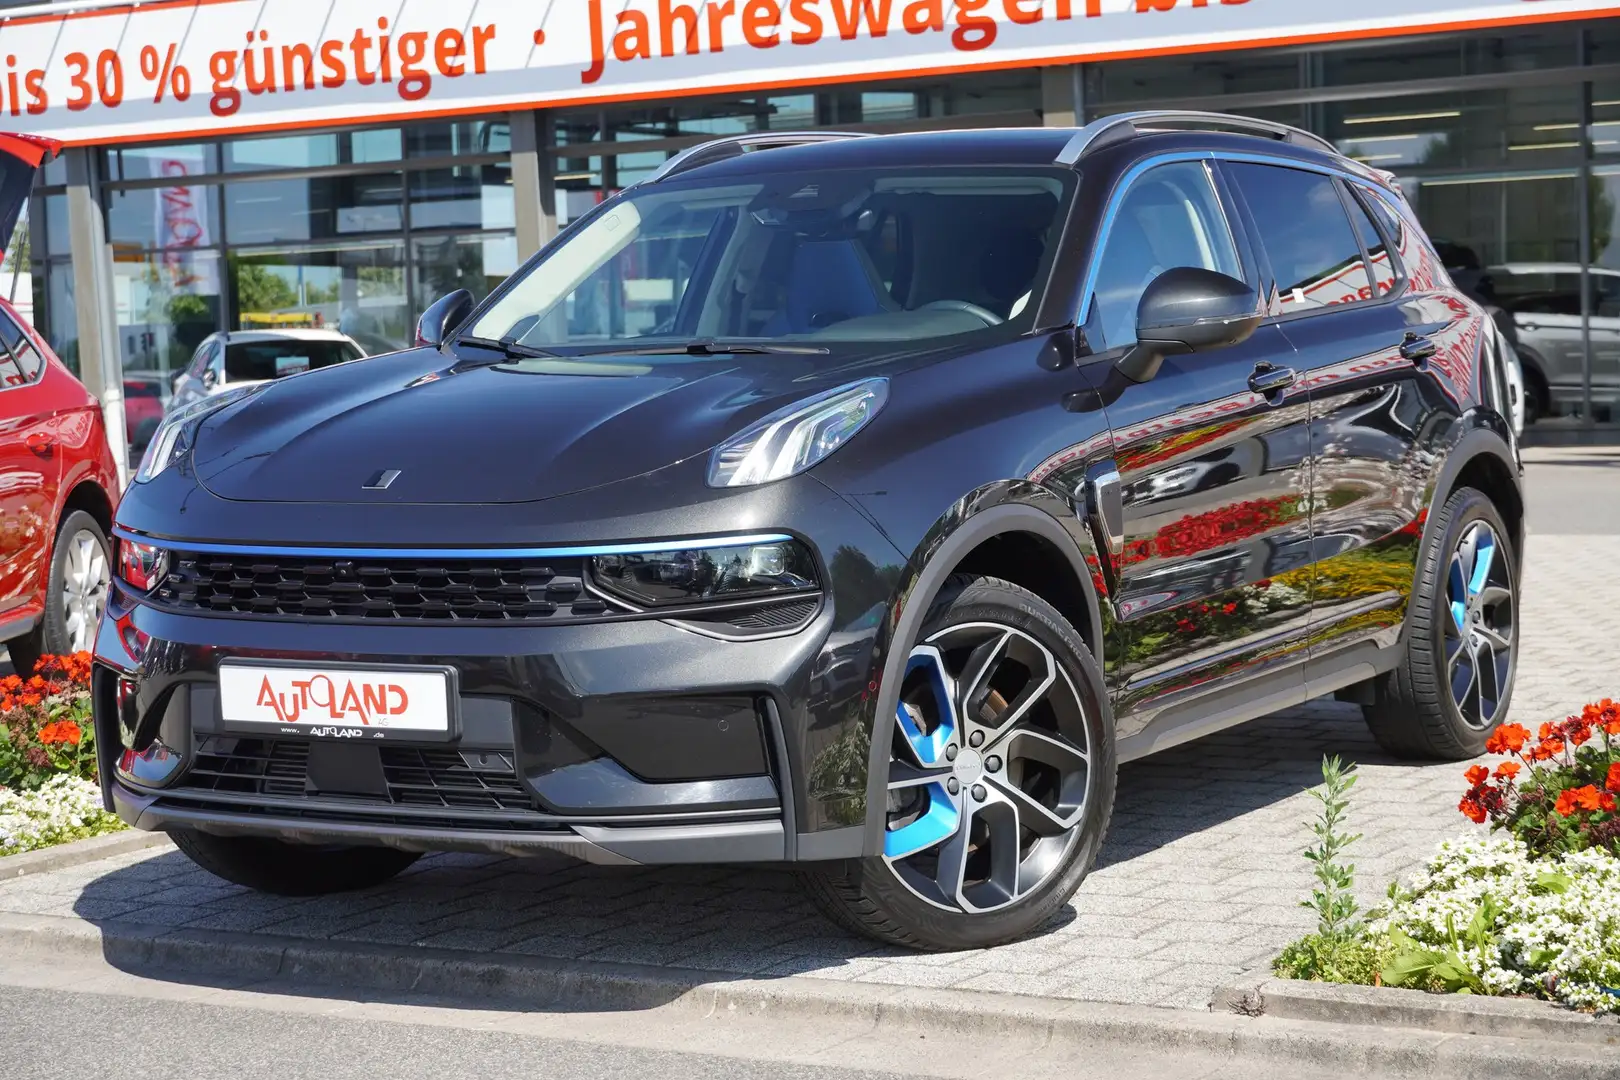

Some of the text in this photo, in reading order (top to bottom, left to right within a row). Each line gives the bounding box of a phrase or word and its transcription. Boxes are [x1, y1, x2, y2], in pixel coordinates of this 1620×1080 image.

[64, 49, 124, 111] 30
[140, 43, 191, 103] %
[209, 16, 497, 117] günstiger
